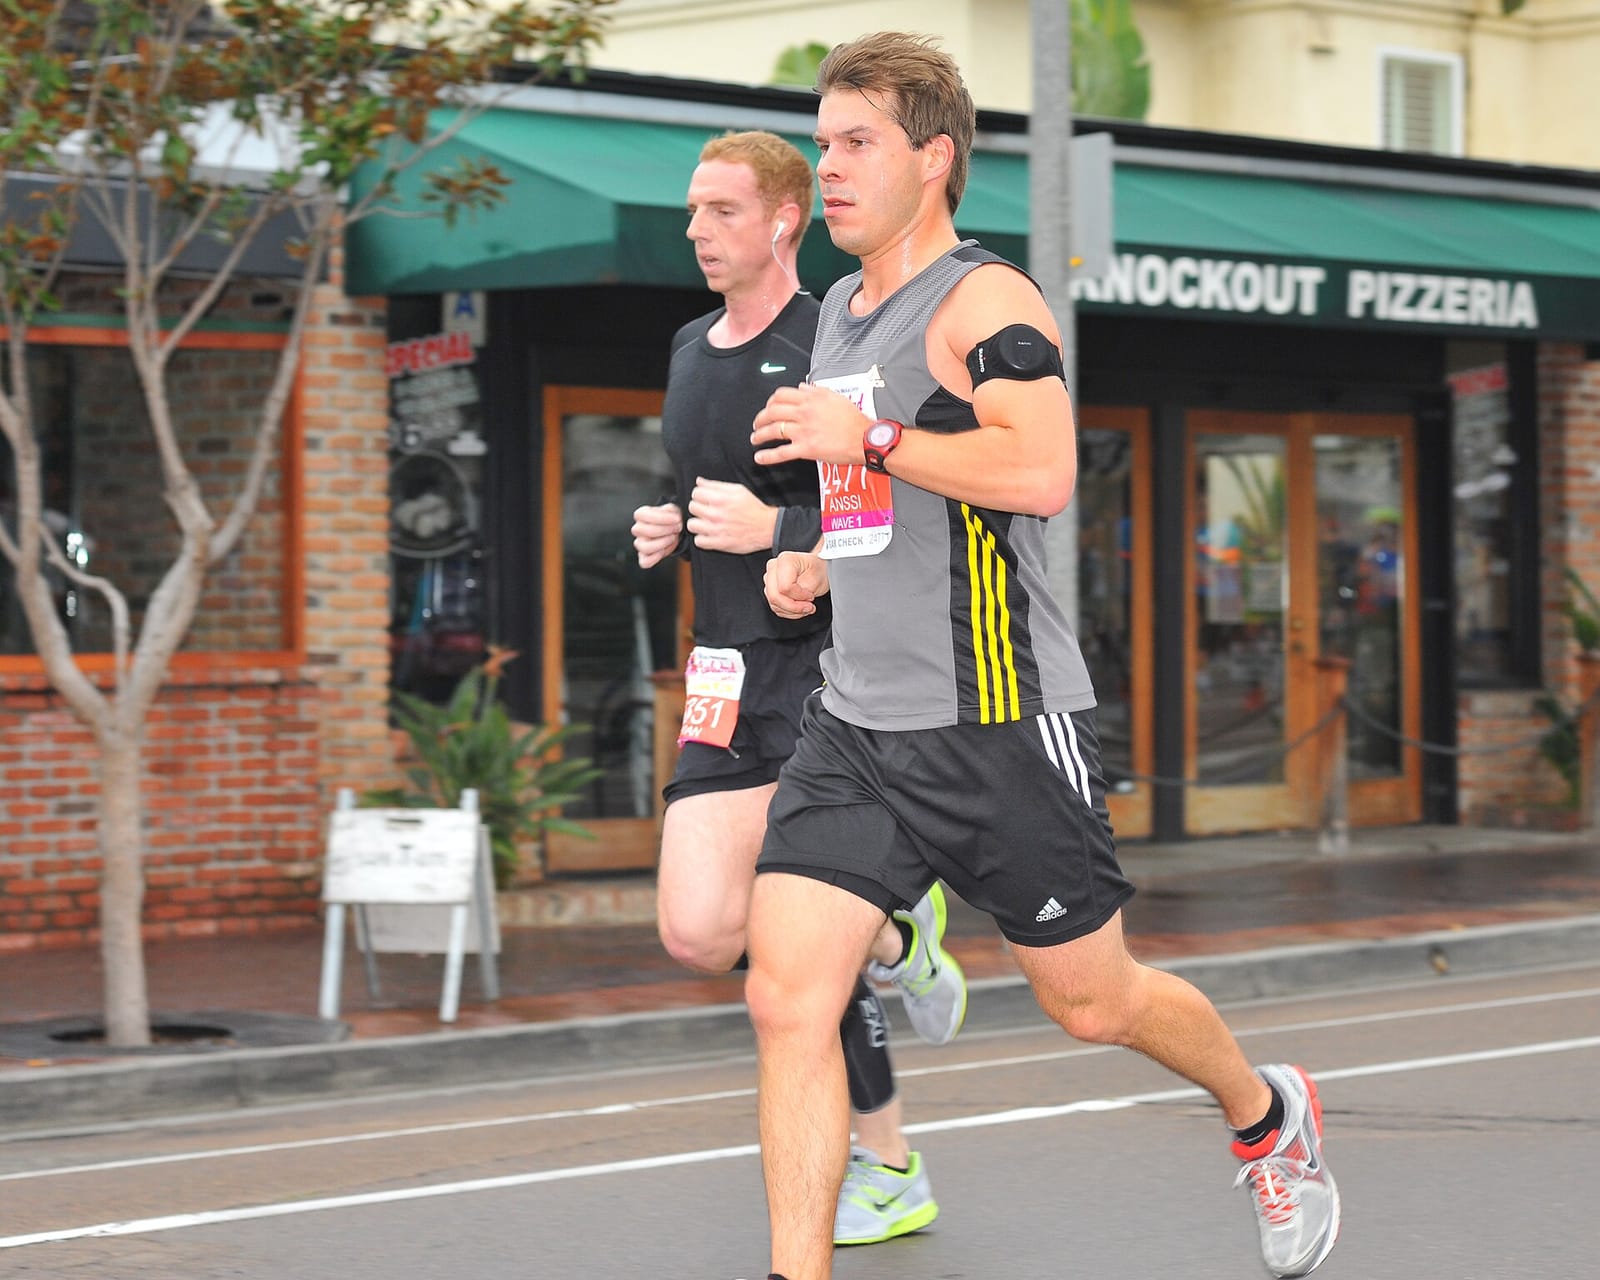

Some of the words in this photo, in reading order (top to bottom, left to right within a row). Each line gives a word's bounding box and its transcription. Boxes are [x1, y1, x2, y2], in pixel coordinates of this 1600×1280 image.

[1347, 270, 1538, 328] PIZZERIA
[385, 331, 475, 377] SPECIAL
[829, 494, 862, 512] ANSSI
[831, 516, 855, 530] WAVE
[856, 515, 863, 528] 1
[838, 533, 863, 548] CHECK
[1035, 907, 1068, 922] adidas
